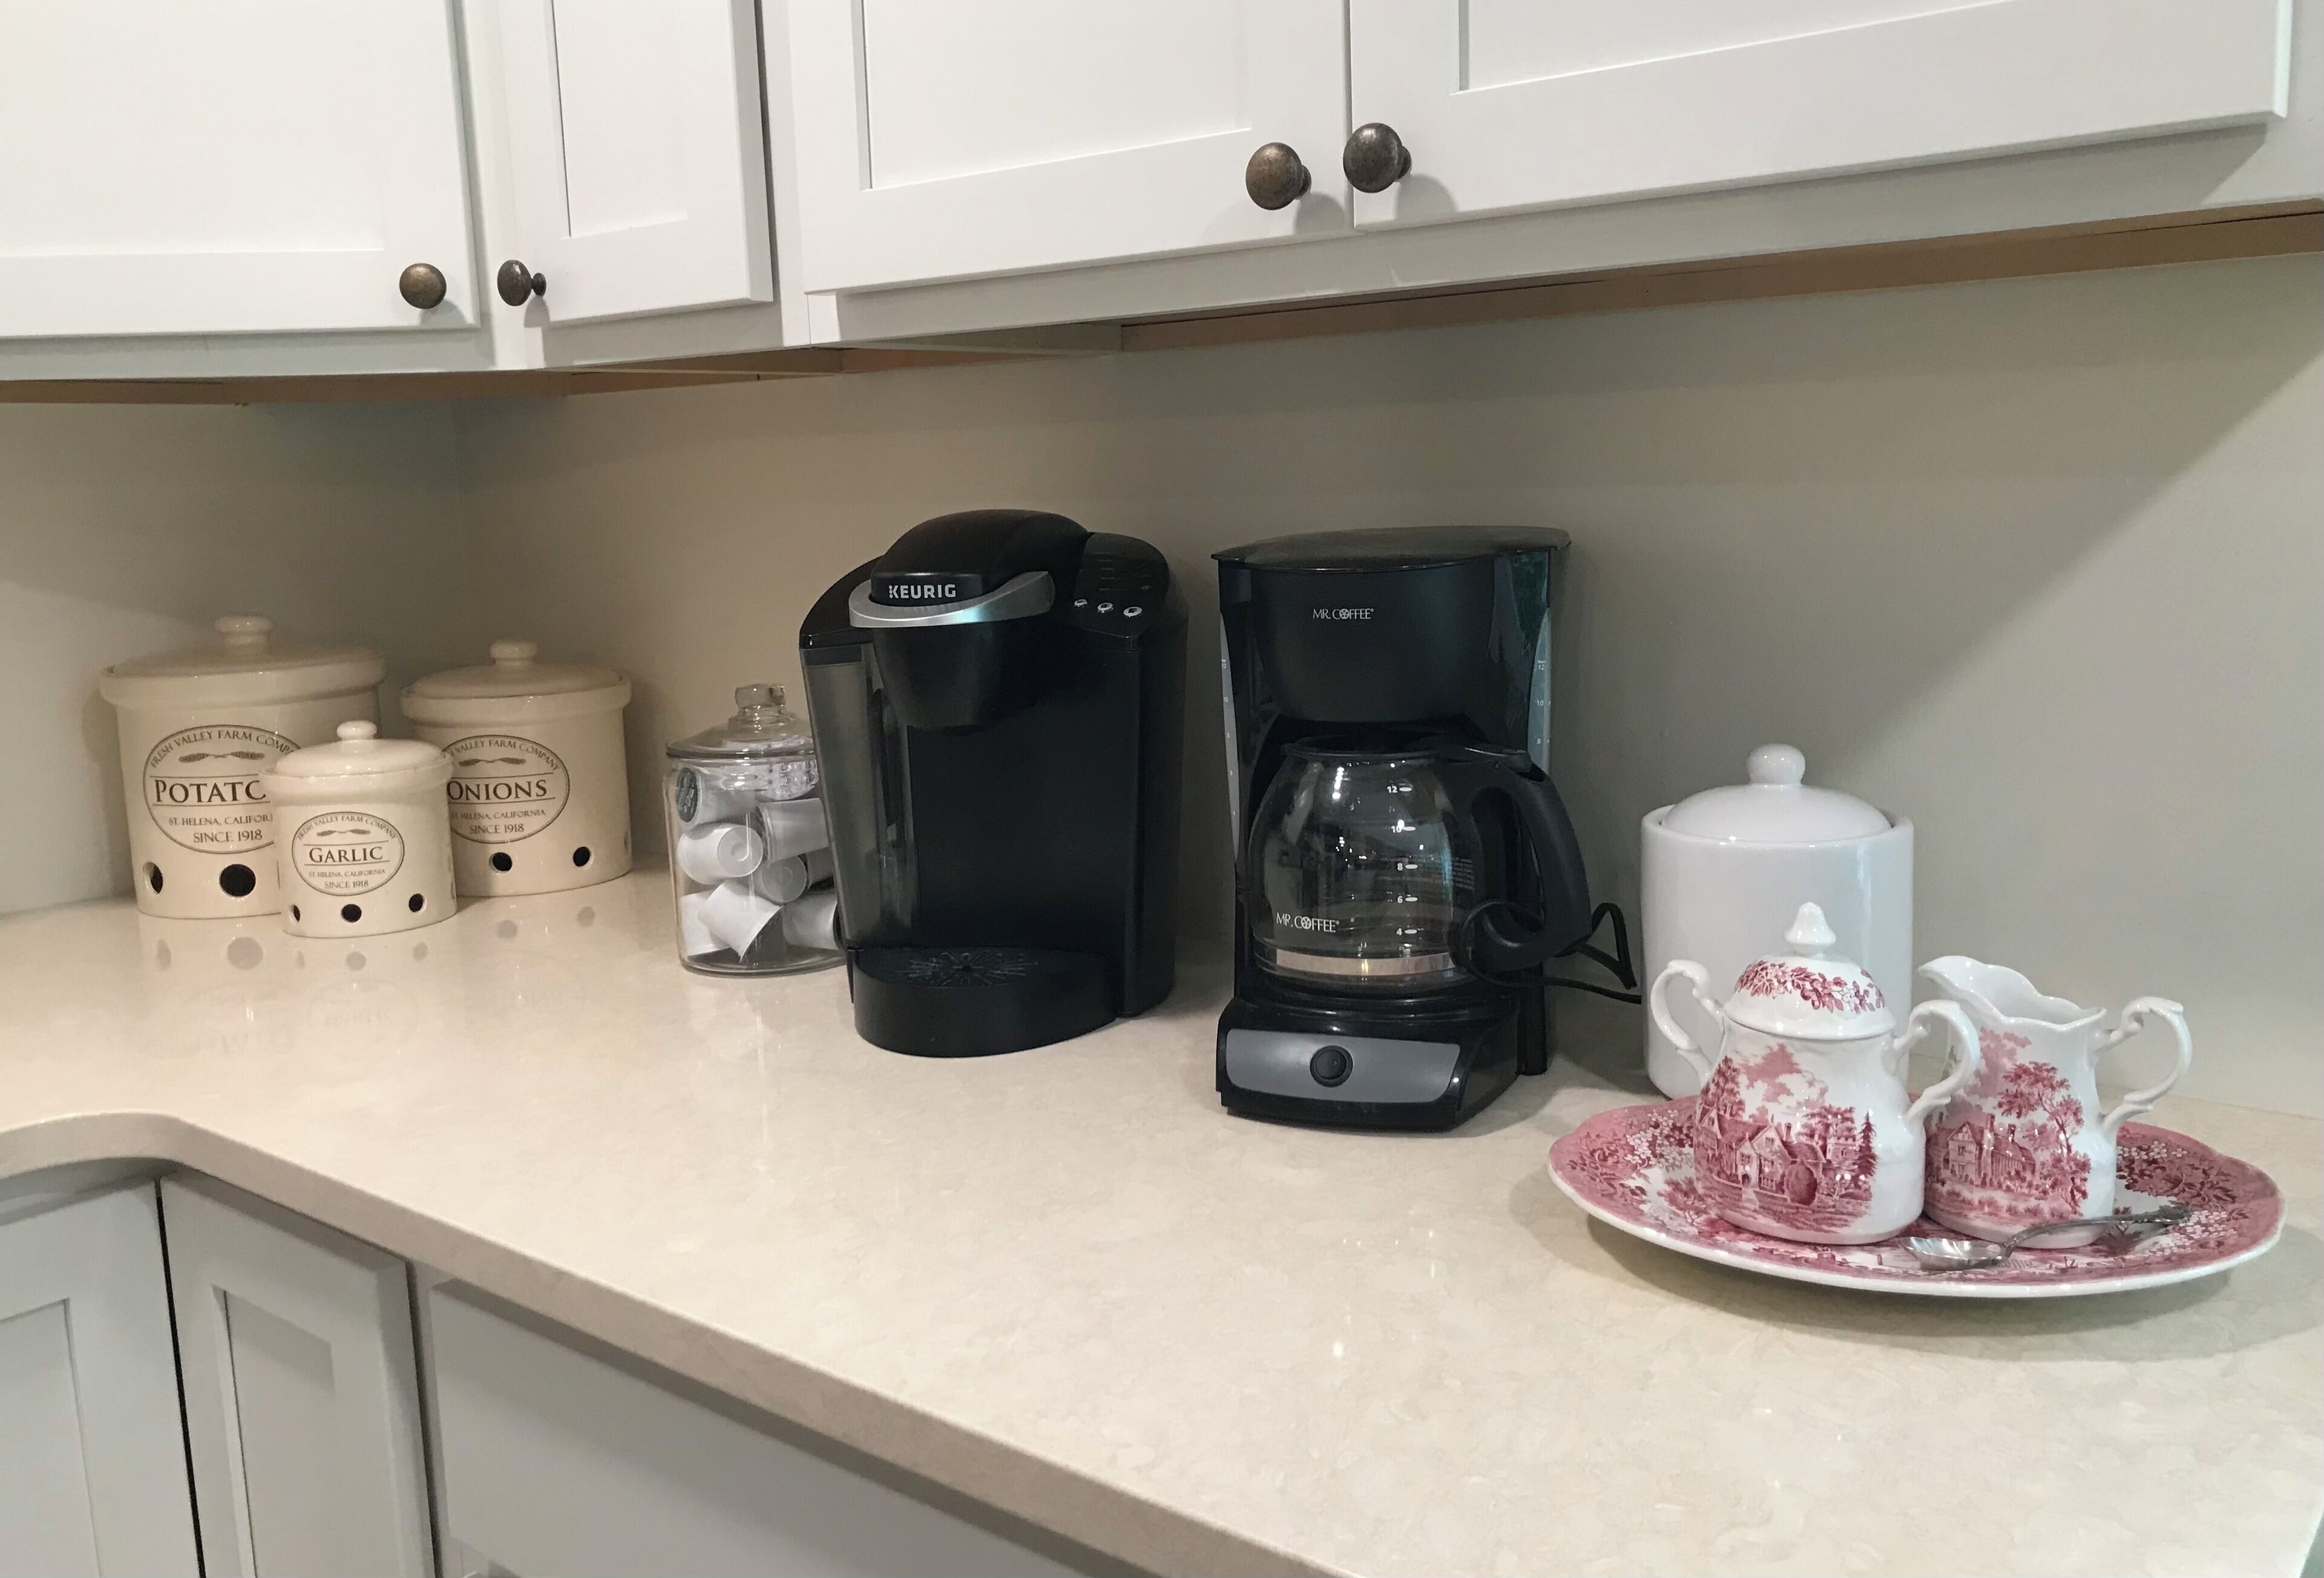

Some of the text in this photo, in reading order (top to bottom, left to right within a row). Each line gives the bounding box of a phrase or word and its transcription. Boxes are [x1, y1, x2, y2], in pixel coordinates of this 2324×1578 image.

[888, 584, 956, 598] KEURIG
[1313, 608, 1331, 620] MR.
[151, 743, 174, 768] FRESH
[174, 730, 214, 747] VALLEY
[218, 730, 252, 742] FARM
[455, 739, 485, 754] VALLEY
[488, 739, 517, 749] FARM
[519, 743, 560, 771] COMPANY
[447, 779, 548, 801] ONIONS
[493, 808, 547, 819] CALIFORNIA
[182, 817, 222, 826] HELENA,
[297, 814, 398, 840] FRESH VALLEY FARM COMPANY
[469, 823, 525, 834] SINCE 1918
[193, 829, 263, 843] SINCE 1918
[309, 846, 384, 863] GARLIC
[344, 868, 386, 877] CALIFORNIA
[1397, 862, 1403, 871] 8
[324, 879, 369, 889] SINCE 1918
[1397, 895, 1403, 904] 6
[1276, 911, 1294, 928] MR.
[1396, 928, 1403, 936] 4
